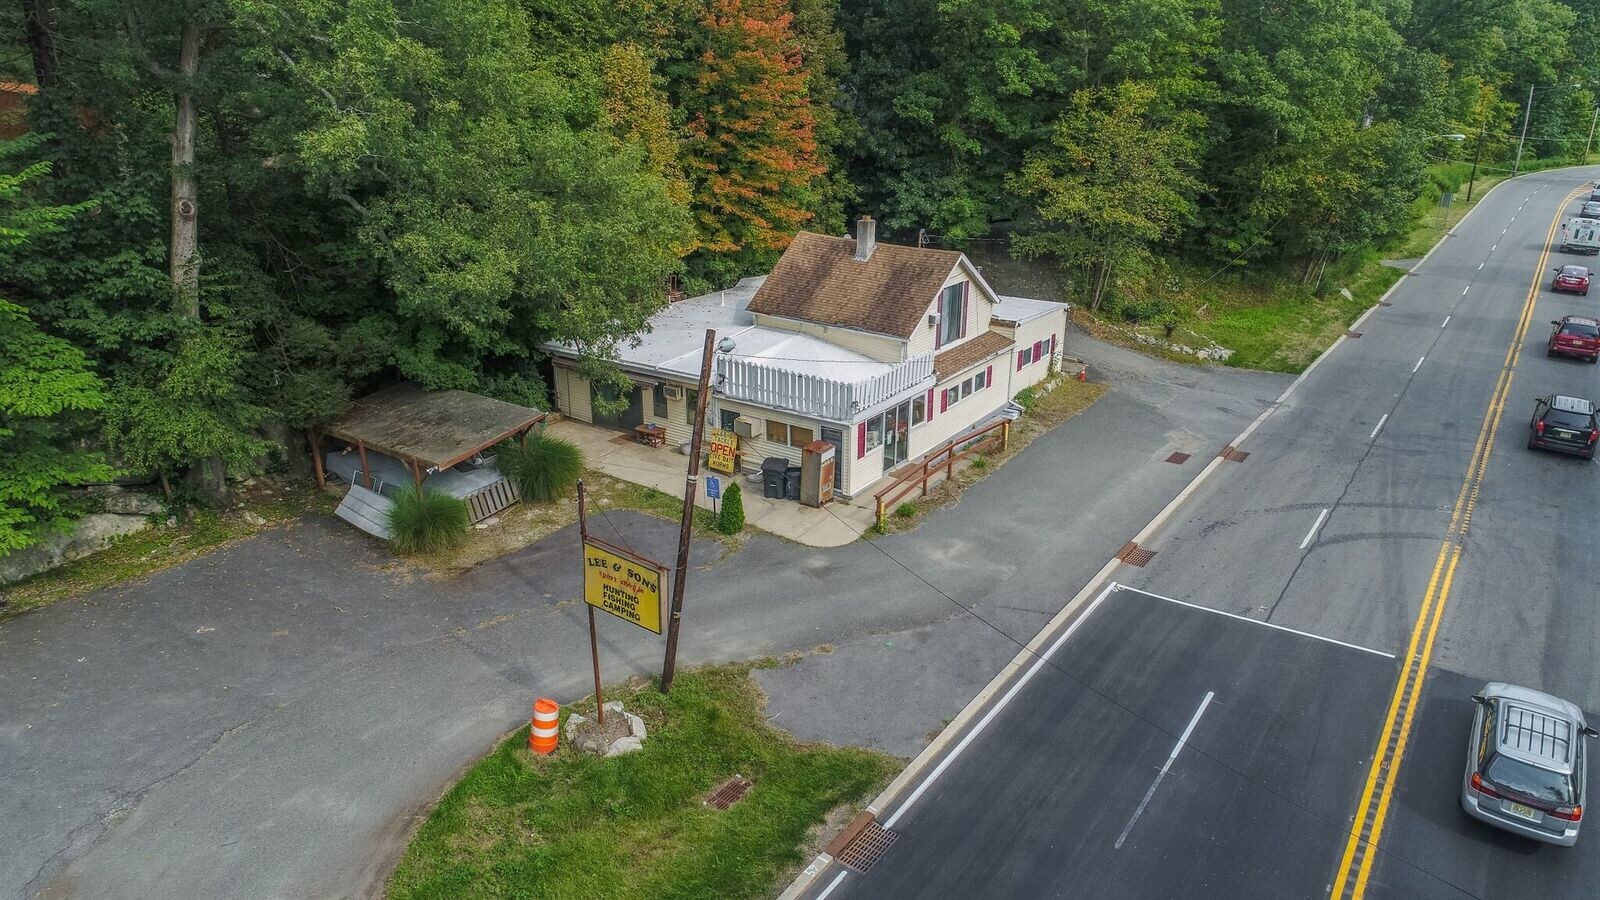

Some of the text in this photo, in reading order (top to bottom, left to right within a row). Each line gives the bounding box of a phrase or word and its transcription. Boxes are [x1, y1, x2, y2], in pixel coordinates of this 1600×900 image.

[710, 453, 721, 461] LIVE
[711, 442, 736, 458] OPEN
[587, 557, 608, 569] LEE
[613, 562, 622, 572] &
[603, 584, 640, 605] HUNTING
[603, 592, 636, 611] FISHING
[603, 600, 641, 621] CAMPING
